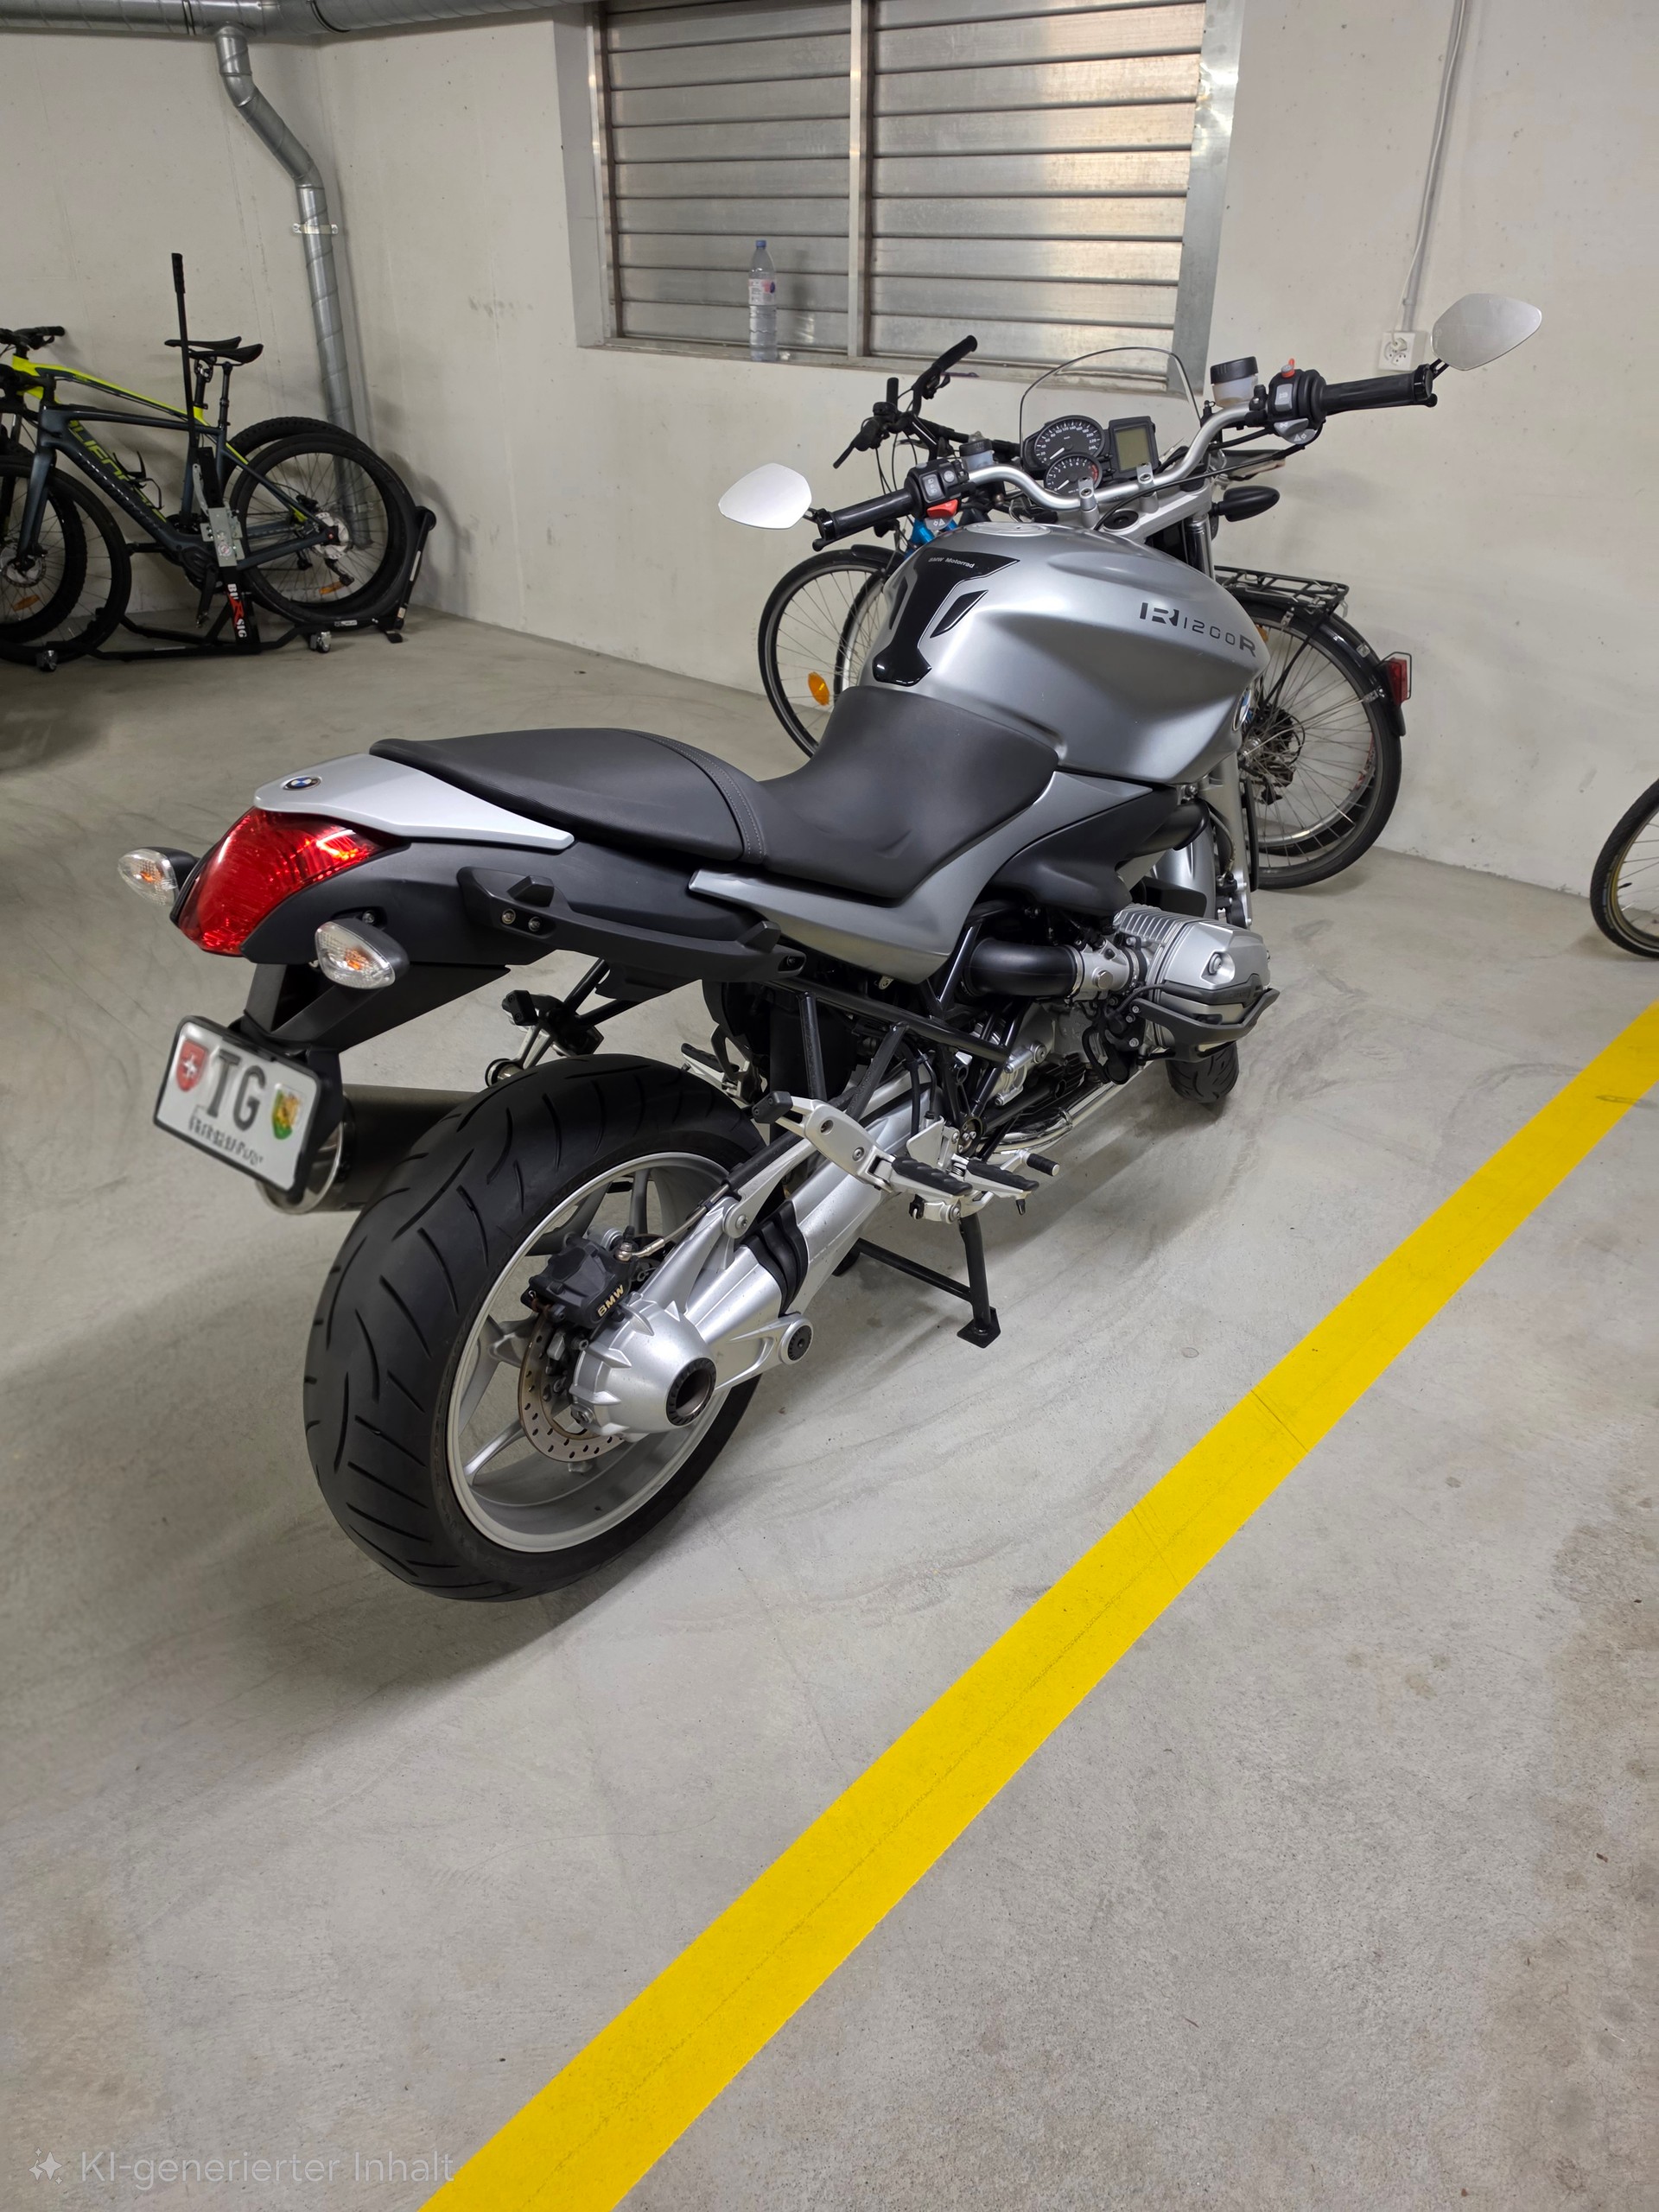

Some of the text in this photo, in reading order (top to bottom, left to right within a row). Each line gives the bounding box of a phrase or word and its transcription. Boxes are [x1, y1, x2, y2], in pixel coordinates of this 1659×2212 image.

[945, 557, 975, 568] Motorrad
[207, 1048, 267, 1131] TG
[597, 1284, 624, 1317] BMW
